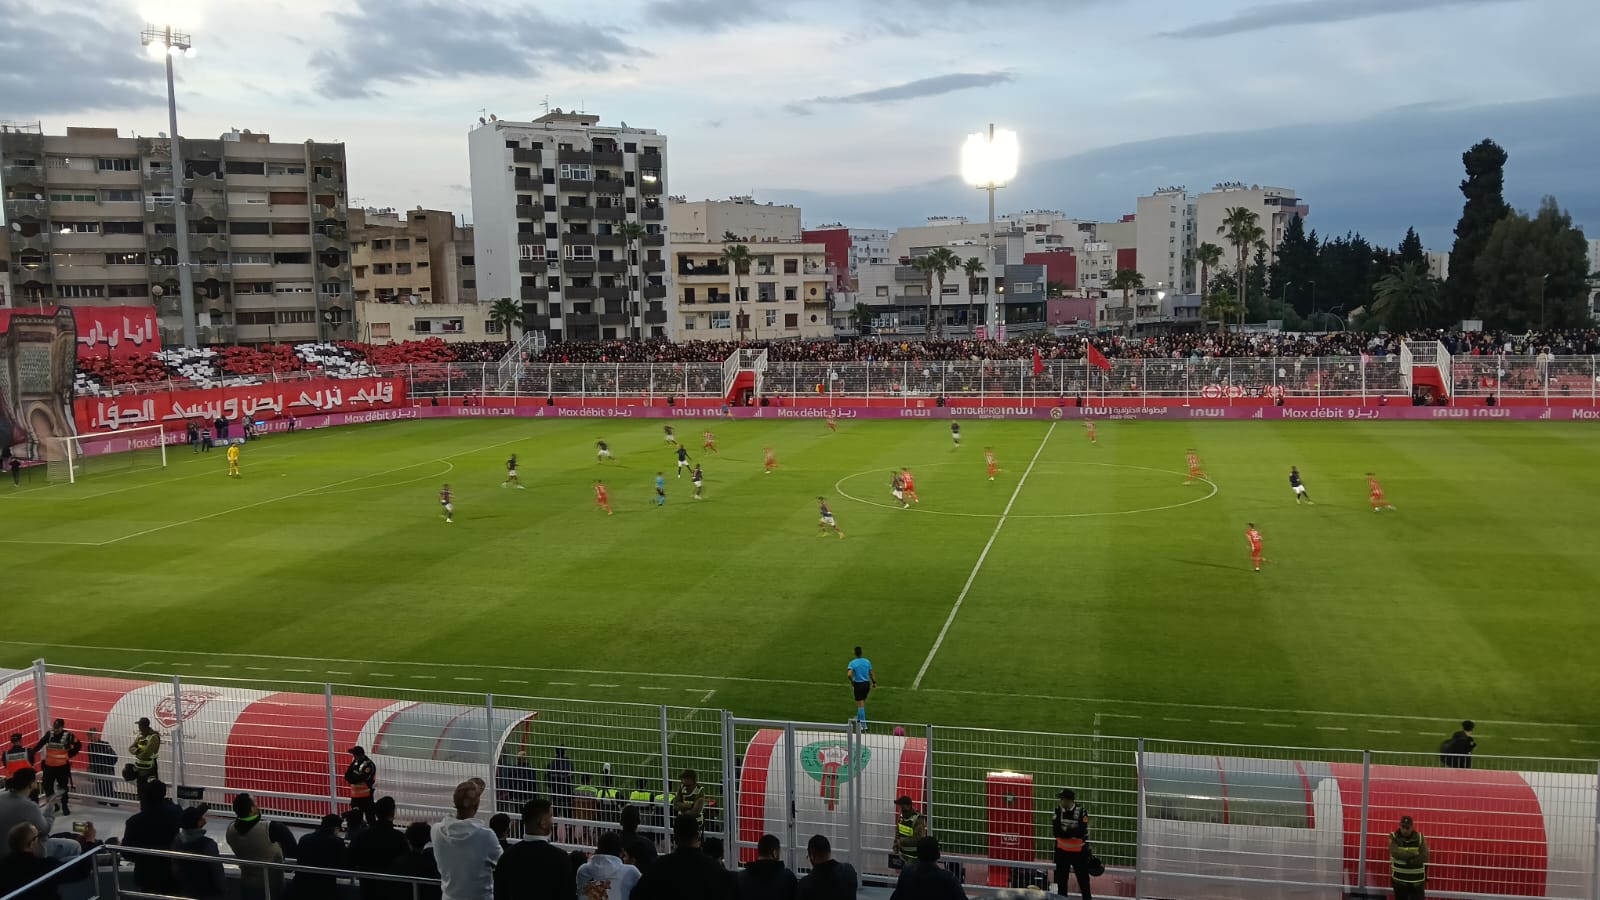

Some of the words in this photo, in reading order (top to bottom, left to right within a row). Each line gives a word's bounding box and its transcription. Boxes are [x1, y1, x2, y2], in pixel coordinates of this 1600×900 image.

[348, 382, 394, 406] قلبي
[345, 414, 365, 424] Max
[365, 411, 391, 423] débit
[558, 408, 579, 417] Max
[579, 407, 605, 417] débit
[777, 408, 800, 418] Max
[800, 407, 828, 418] débit
[1282, 408, 1309, 418] Max
[1310, 407, 1344, 418] débit
[1572, 408, 1600, 419] Max
[127, 437, 151, 450] Max
